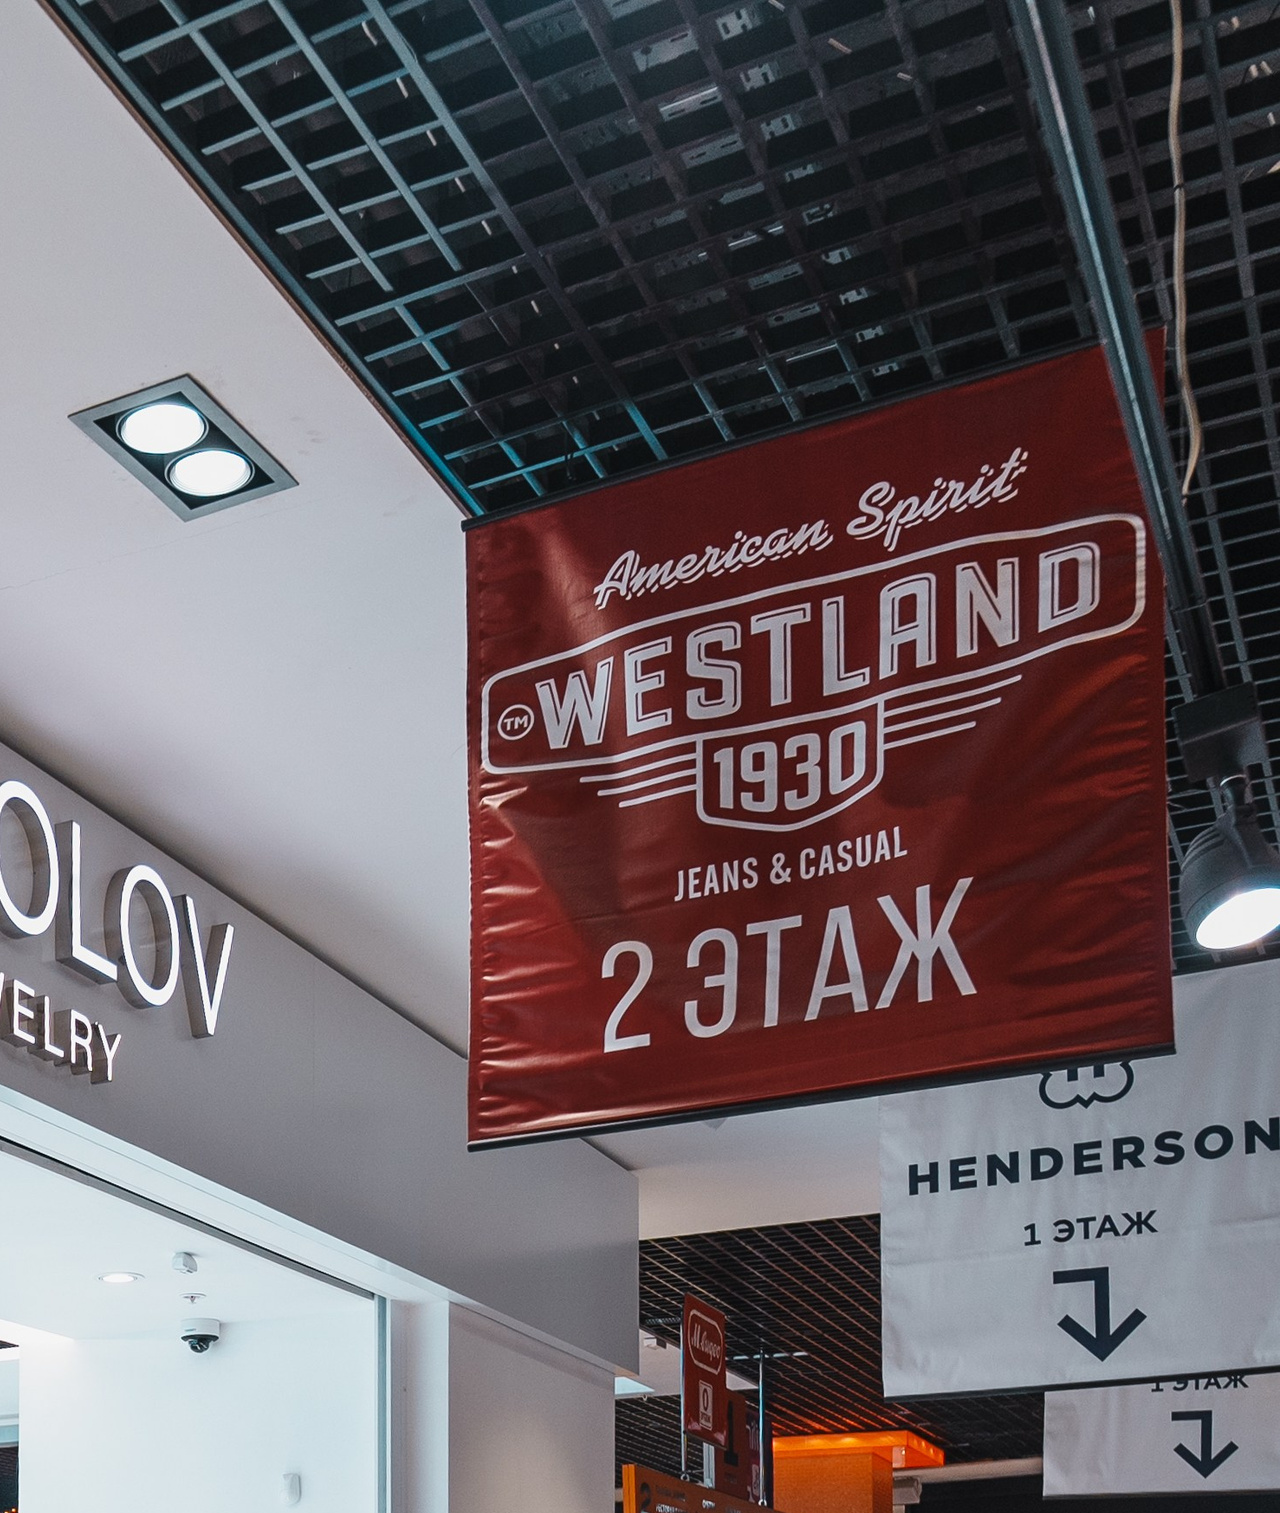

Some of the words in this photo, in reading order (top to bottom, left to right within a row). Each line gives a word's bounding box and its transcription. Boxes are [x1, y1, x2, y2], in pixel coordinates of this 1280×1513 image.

[594, 529, 833, 609] American
[846, 447, 1028, 549] Spirit
[536, 541, 1101, 750] WESTLAND
[504, 715, 530, 731] TM
[713, 720, 866, 812] 1930
[675, 857, 759, 902] JEANS
[770, 860, 791, 884] &
[799, 826, 907, 878] CASUAL
[603, 940, 652, 1053] 2
[685, 878, 977, 1038] ЭТАЖ
[908, 1117, 1280, 1195] HENDERSON
[1024, 1223, 1041, 1246] 1
[1053, 1210, 1158, 1242] ЭТАЖ
